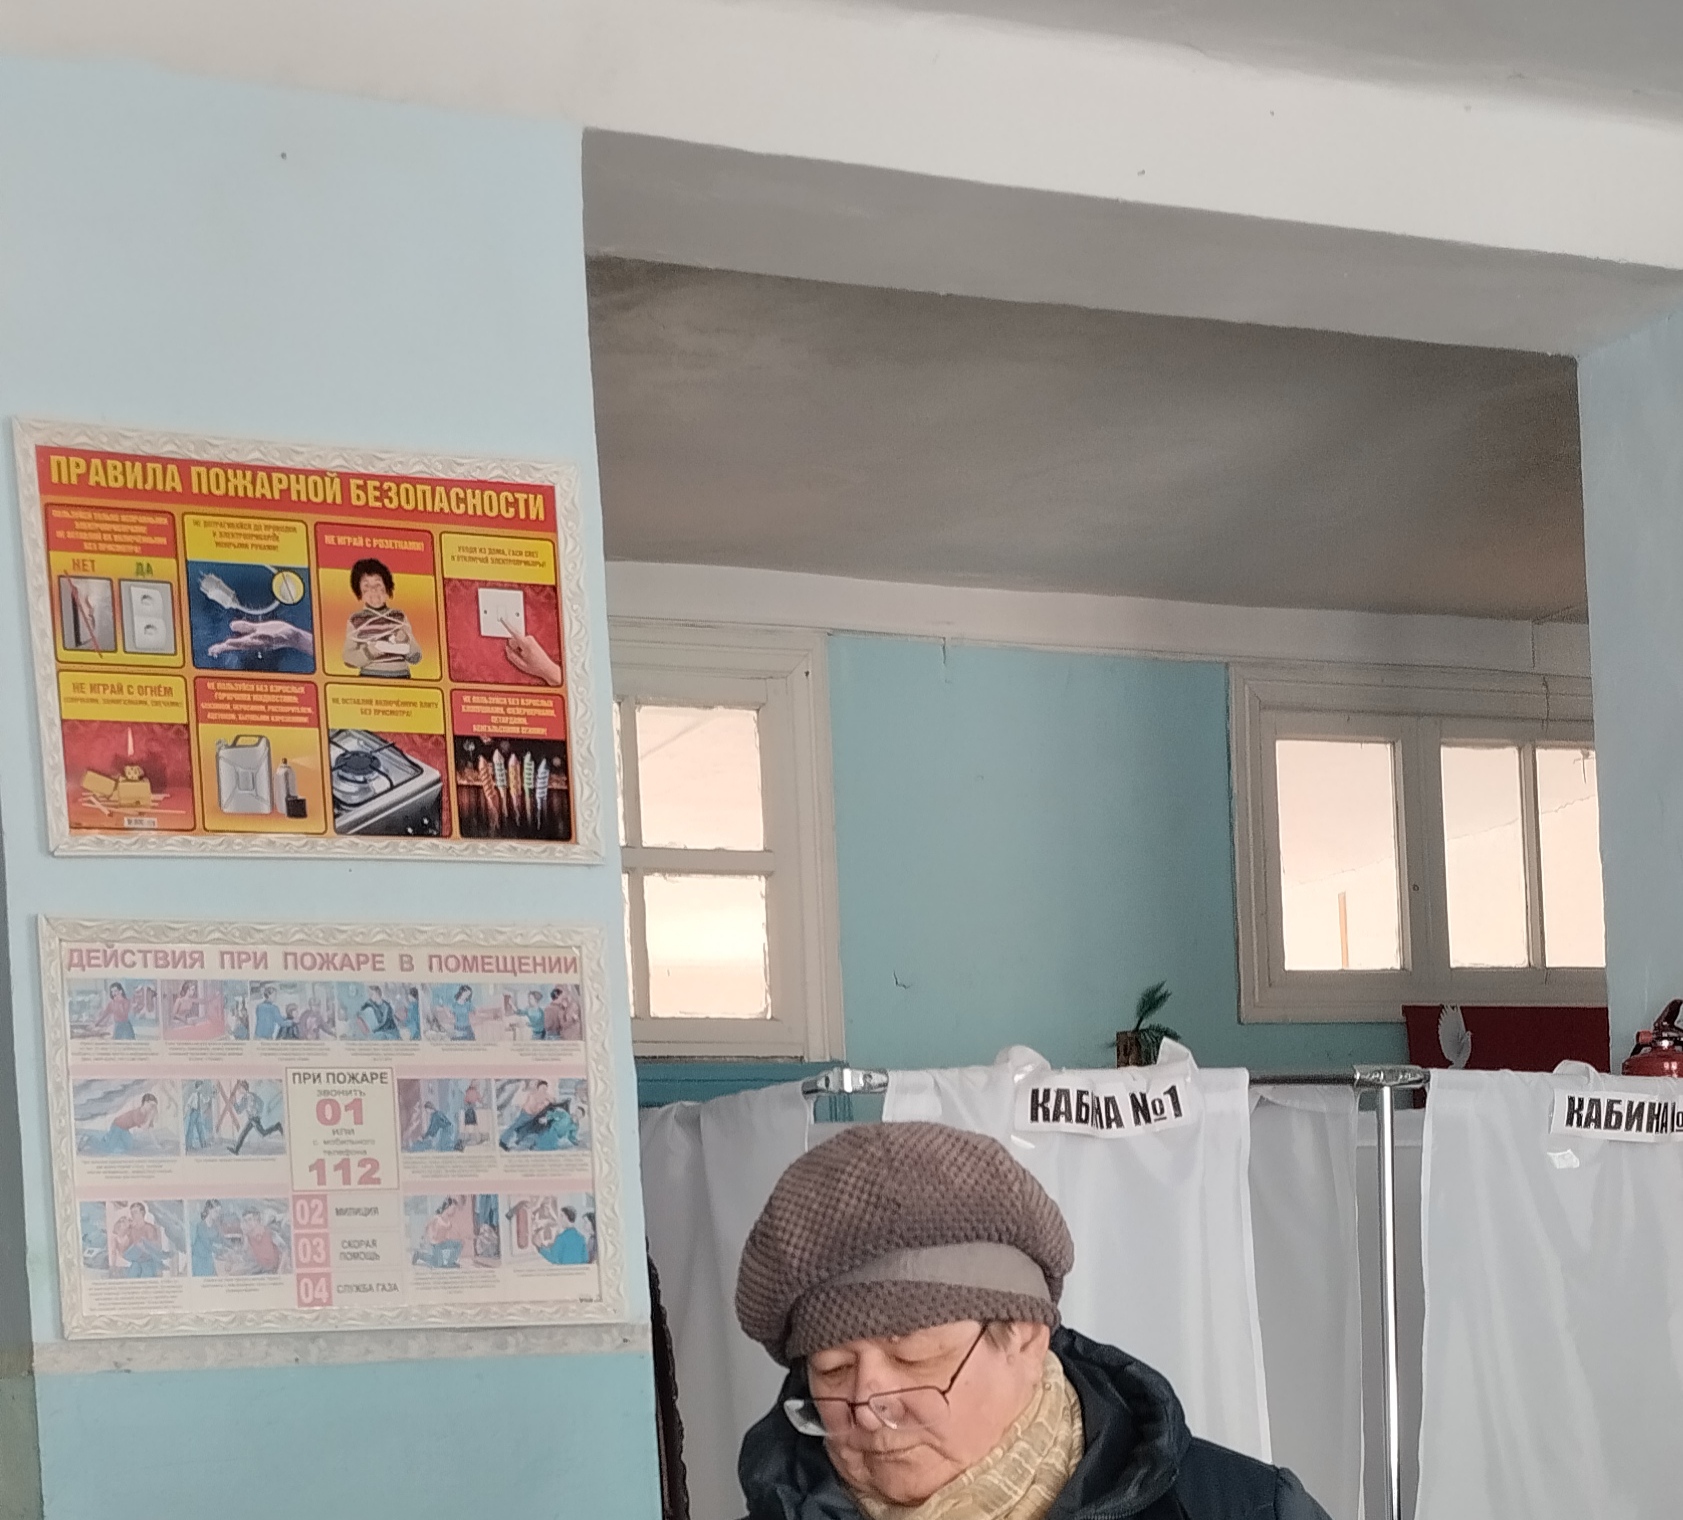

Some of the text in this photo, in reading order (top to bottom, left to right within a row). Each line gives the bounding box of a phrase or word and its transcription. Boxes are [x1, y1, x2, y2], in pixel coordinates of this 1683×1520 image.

[50, 455, 545, 521] ПРАВИЛА ПОЖАРНОЙ БЕЗОПАСНОСТИ
[72, 558, 154, 577] НЕТ ДА
[72, 682, 85, 694] НЕ
[89, 682, 124, 695] ИГРАЙ
[127, 684, 134, 695] С
[67, 943, 578, 977] ДЕЙСТВИЯ ПРИ ПОЖАРЕ В ПОМЕЩЕНИИ
[292, 1071, 389, 1085] ПРИ ПОЖАРЕ
[316, 1098, 364, 1126] 01
[1565, 1095, 1668, 1134] КАБИНА
[308, 1157, 382, 1187] 112
[295, 1198, 324, 1225] 02
[298, 1237, 326, 1264] 03
[339, 1251, 381, 1261] ПОМОЩЬ
[341, 1239, 377, 1249] СКОРАЯ
[300, 1277, 399, 1304] 04 СЛУЖБА ГАЗА
